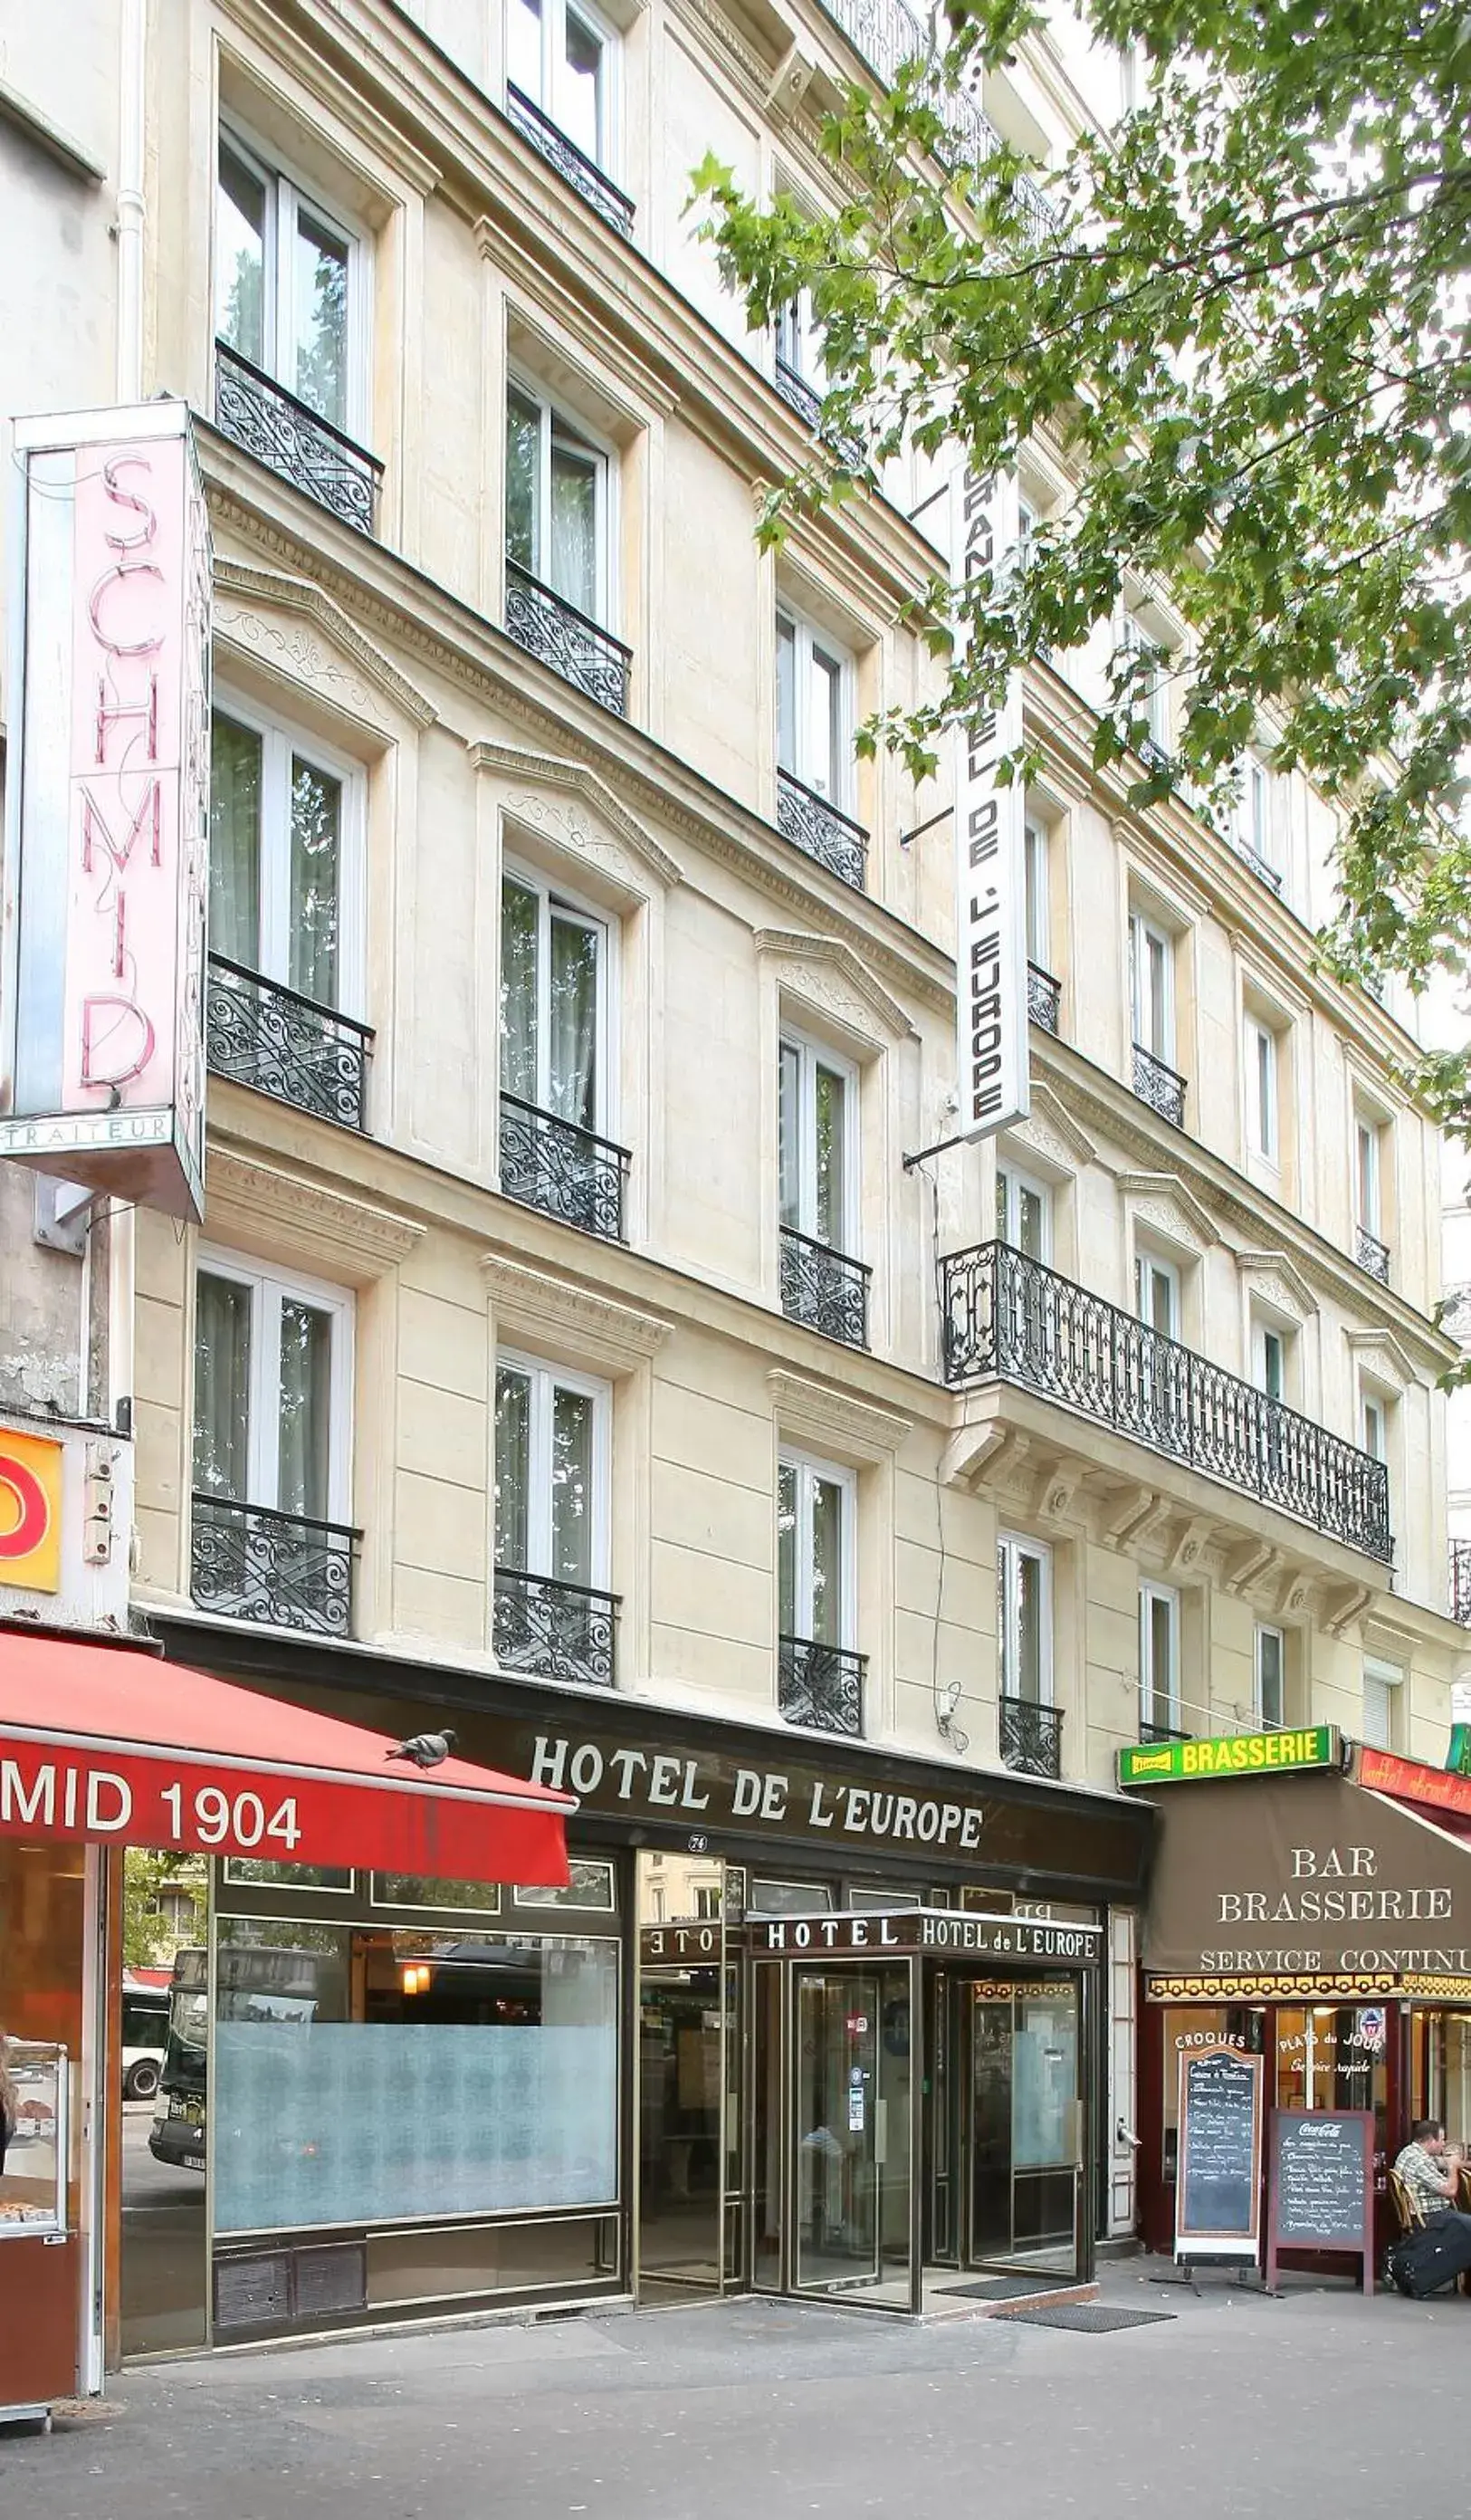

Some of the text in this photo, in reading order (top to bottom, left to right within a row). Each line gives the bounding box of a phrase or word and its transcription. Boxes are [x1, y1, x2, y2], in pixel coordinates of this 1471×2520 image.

[80, 451, 165, 1089] SCHMID
[969, 799, 998, 868] DE
[6, 1118, 166, 1146] TRAITEUR
[1182, 1731, 1319, 1773] BRASSERIE
[0, 1759, 301, 1849] MID 1904
[530, 1736, 984, 1849] HOTEL DE L'EUROPE
[691, 1837, 704, 1849] 74
[1291, 1847, 1377, 1878] BAR
[1217, 1889, 1452, 1922] BRASSERIE
[769, 1918, 898, 1949] HOTEL
[922, 1918, 1094, 1957] HOTEL de L'EUROPE
[1200, 1950, 1471, 1971] SERVICE CONTINU
[1175, 2032, 1246, 2048] CROQUES
[1279, 2031, 1382, 2053] PLATS du JOUR
